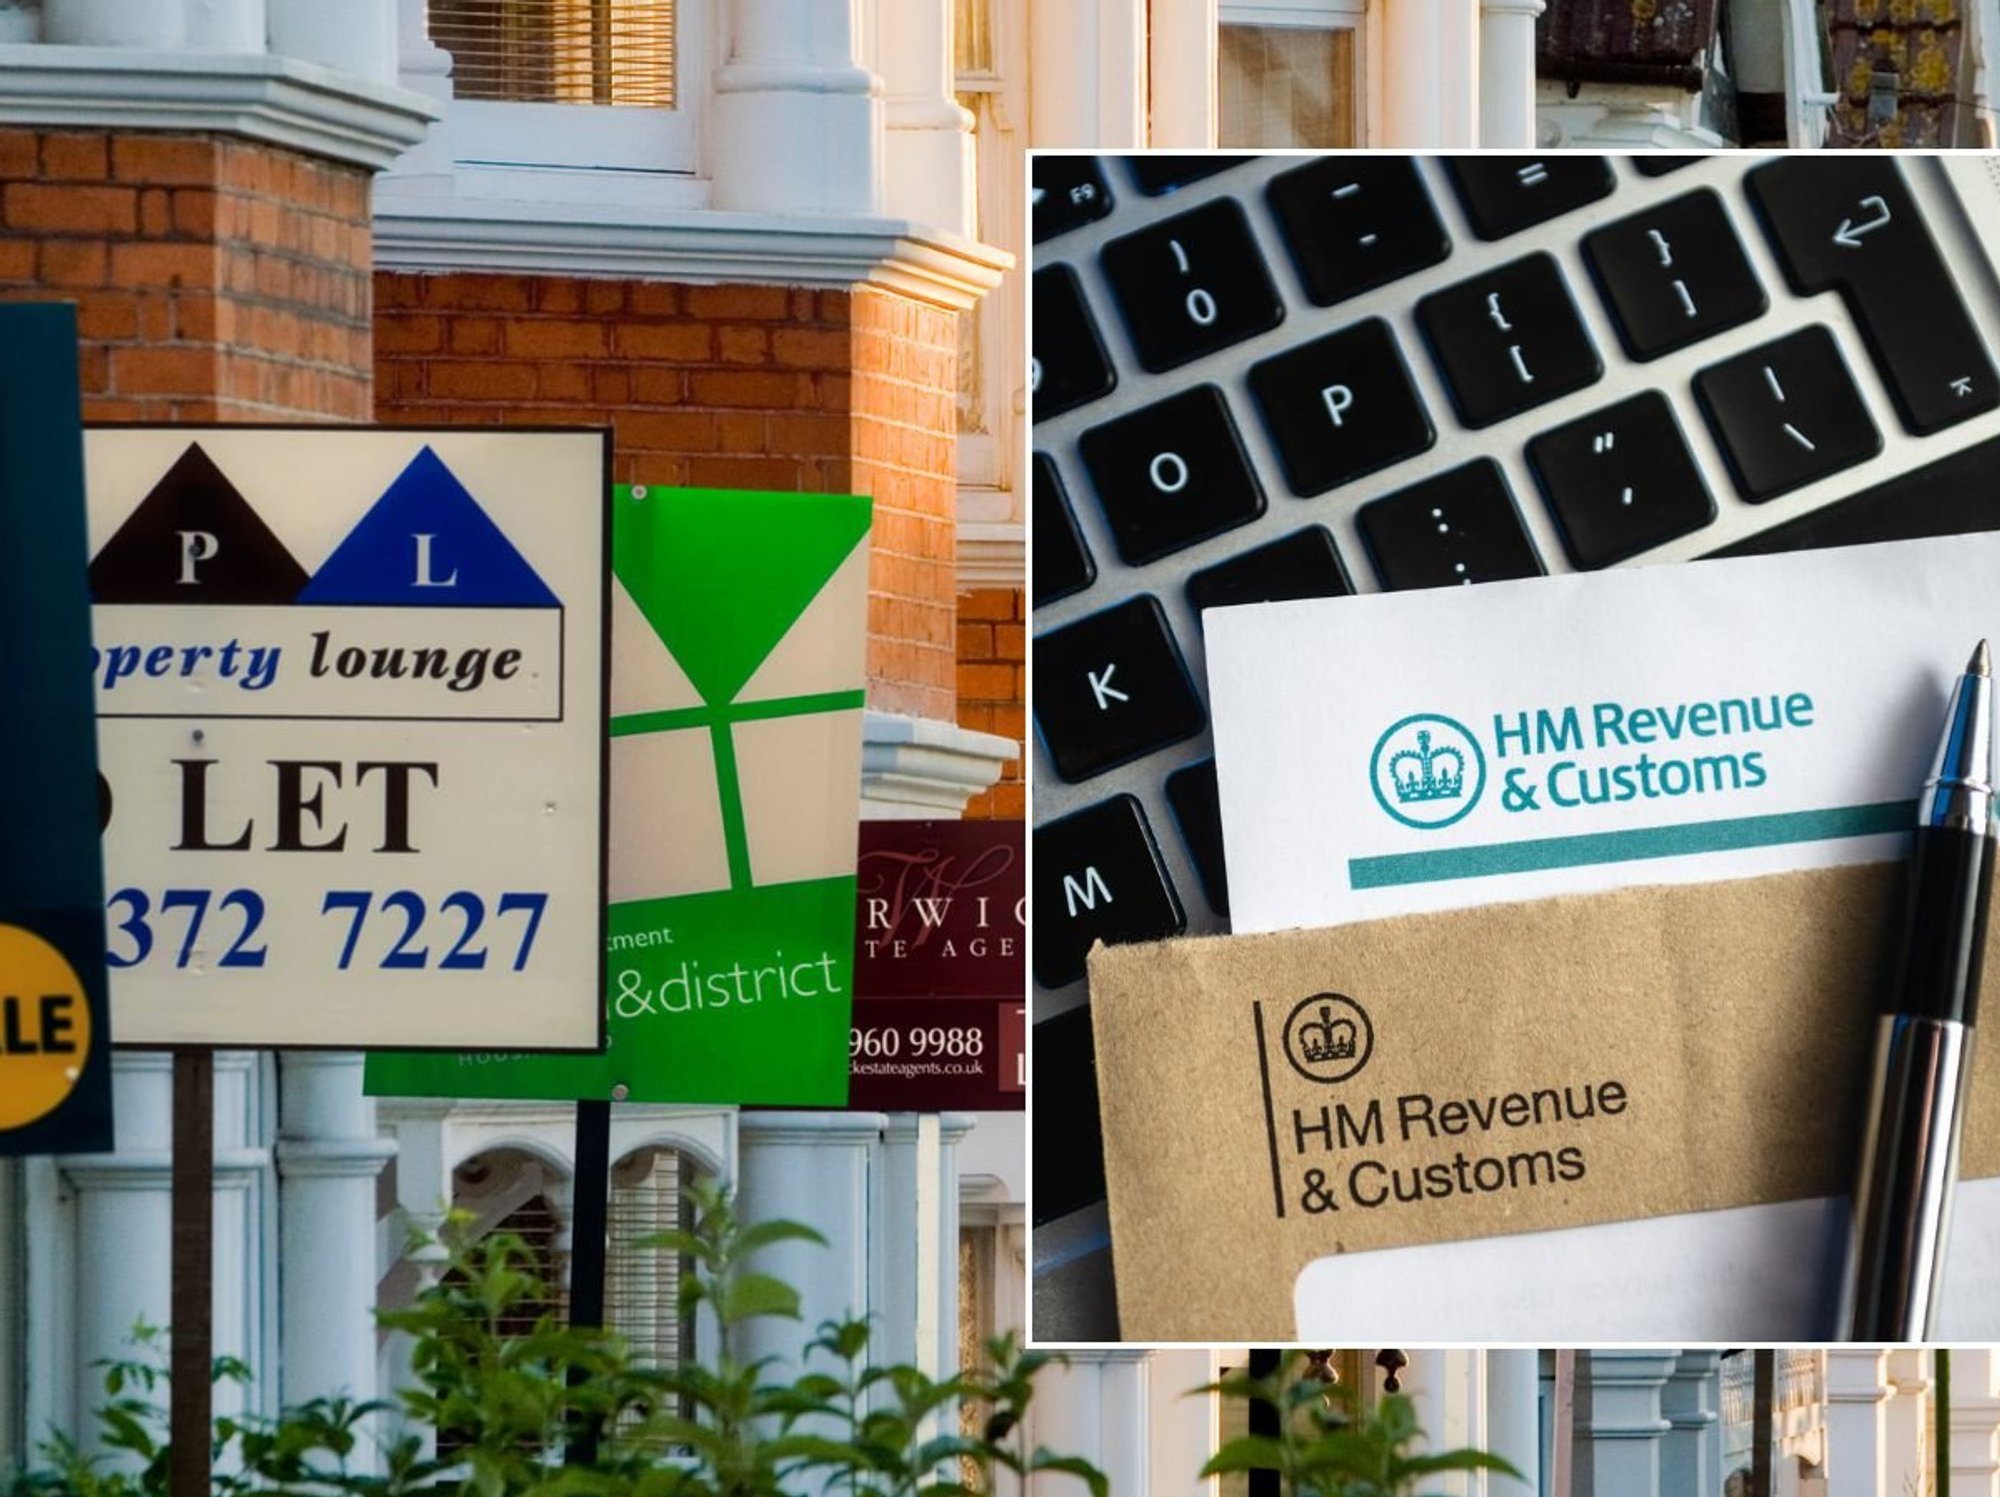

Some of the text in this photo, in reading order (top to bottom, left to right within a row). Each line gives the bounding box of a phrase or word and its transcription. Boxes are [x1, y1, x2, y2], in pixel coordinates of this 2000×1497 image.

[1186, 288, 1217, 326] 0
[1322, 384, 1353, 427] P
[1149, 452, 1189, 493] O
[176, 531, 220, 584] P
[411, 534, 457, 586] L
[309, 630, 523, 692] lounge
[1088, 663, 1129, 711] K
[1493, 692, 1815, 758] HM Revenue
[170, 759, 439, 854] LET
[1501, 750, 1767, 813] & Customs
[1063, 866, 1114, 918] M
[104, 887, 549, 973] 372 7227
[606, 950, 843, 1020] &district
[0, 994, 77, 1055] LE
[849, 1027, 984, 1058] 960 9988
[1292, 1080, 1628, 1155] HM Revenue
[1300, 1146, 1587, 1215] & Customs
